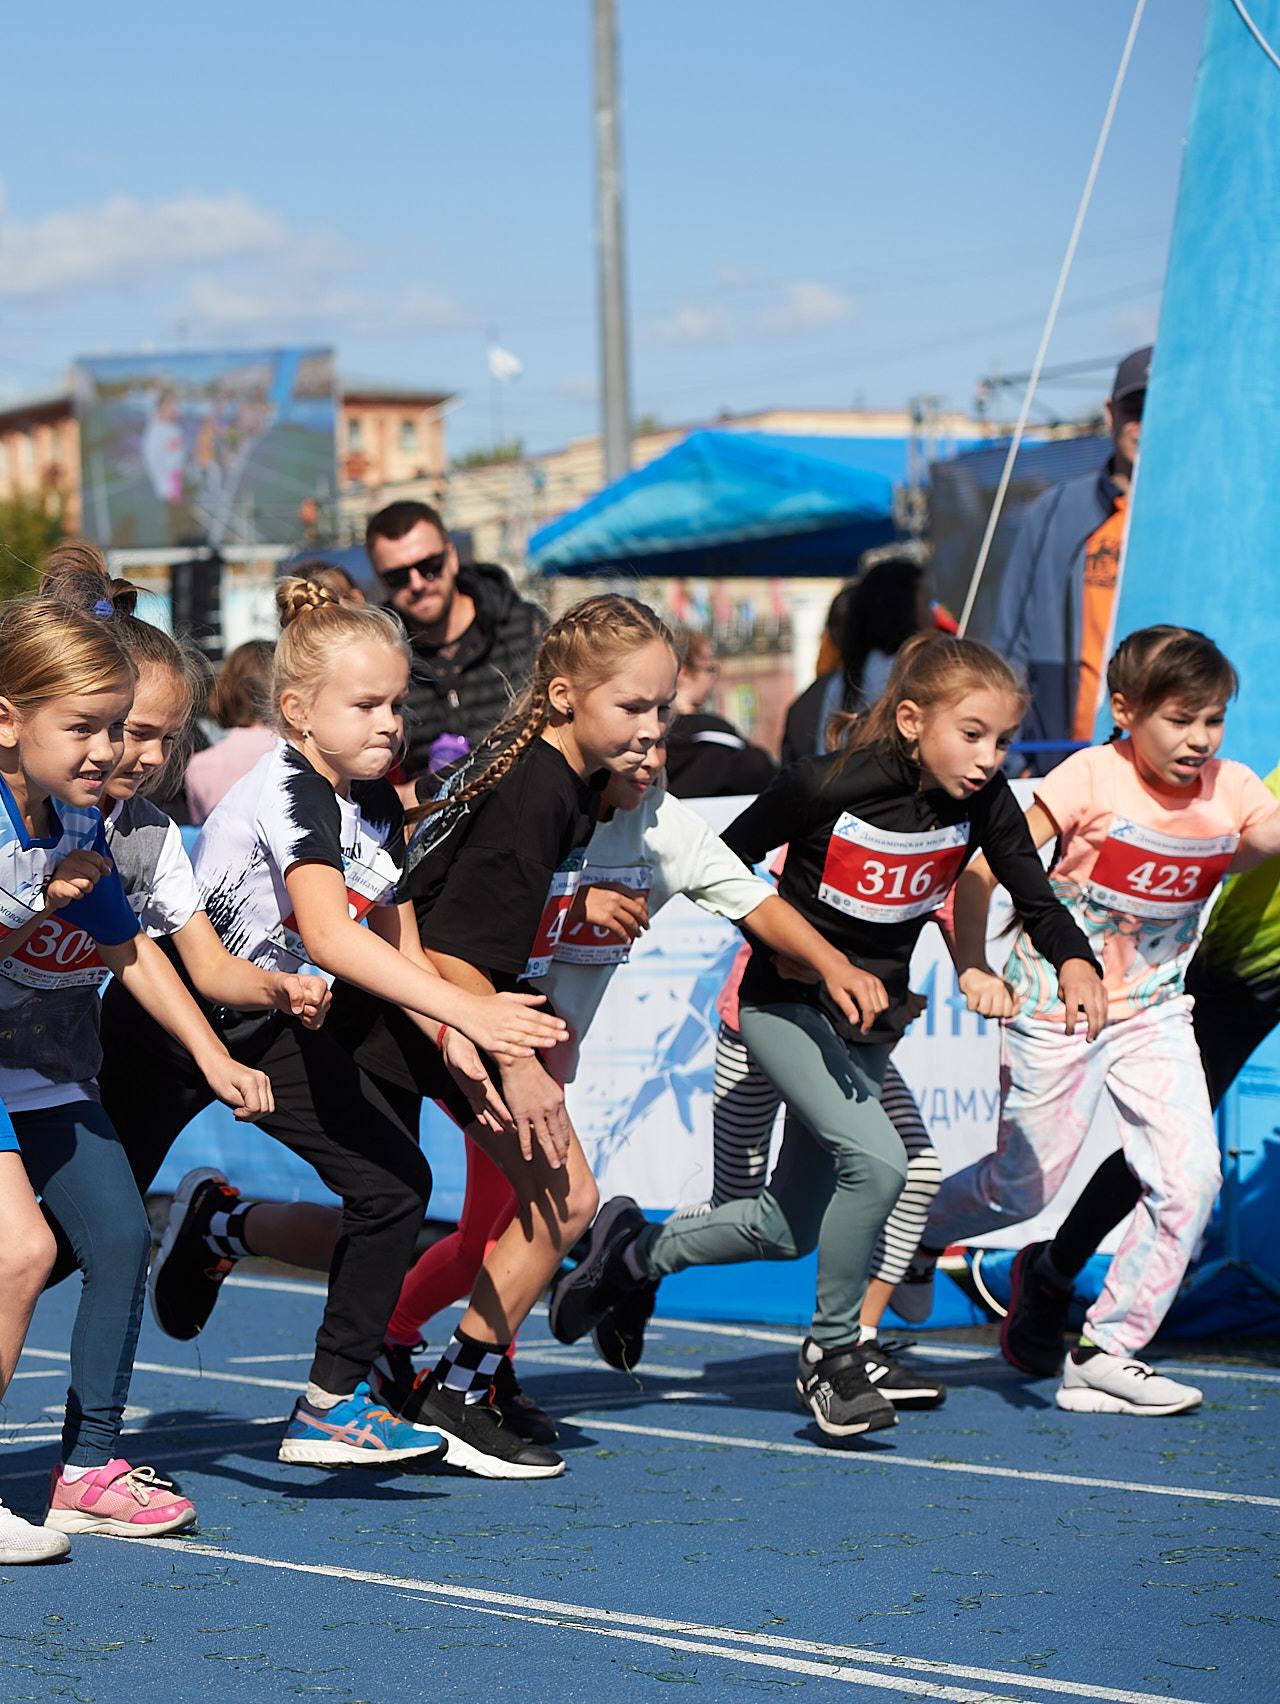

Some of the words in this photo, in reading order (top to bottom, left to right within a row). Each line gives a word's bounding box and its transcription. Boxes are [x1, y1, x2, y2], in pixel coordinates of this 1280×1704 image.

[856, 860, 935, 899] 316
[1126, 861, 1202, 897] 423
[911, 1087, 1001, 1130] УДМУ
